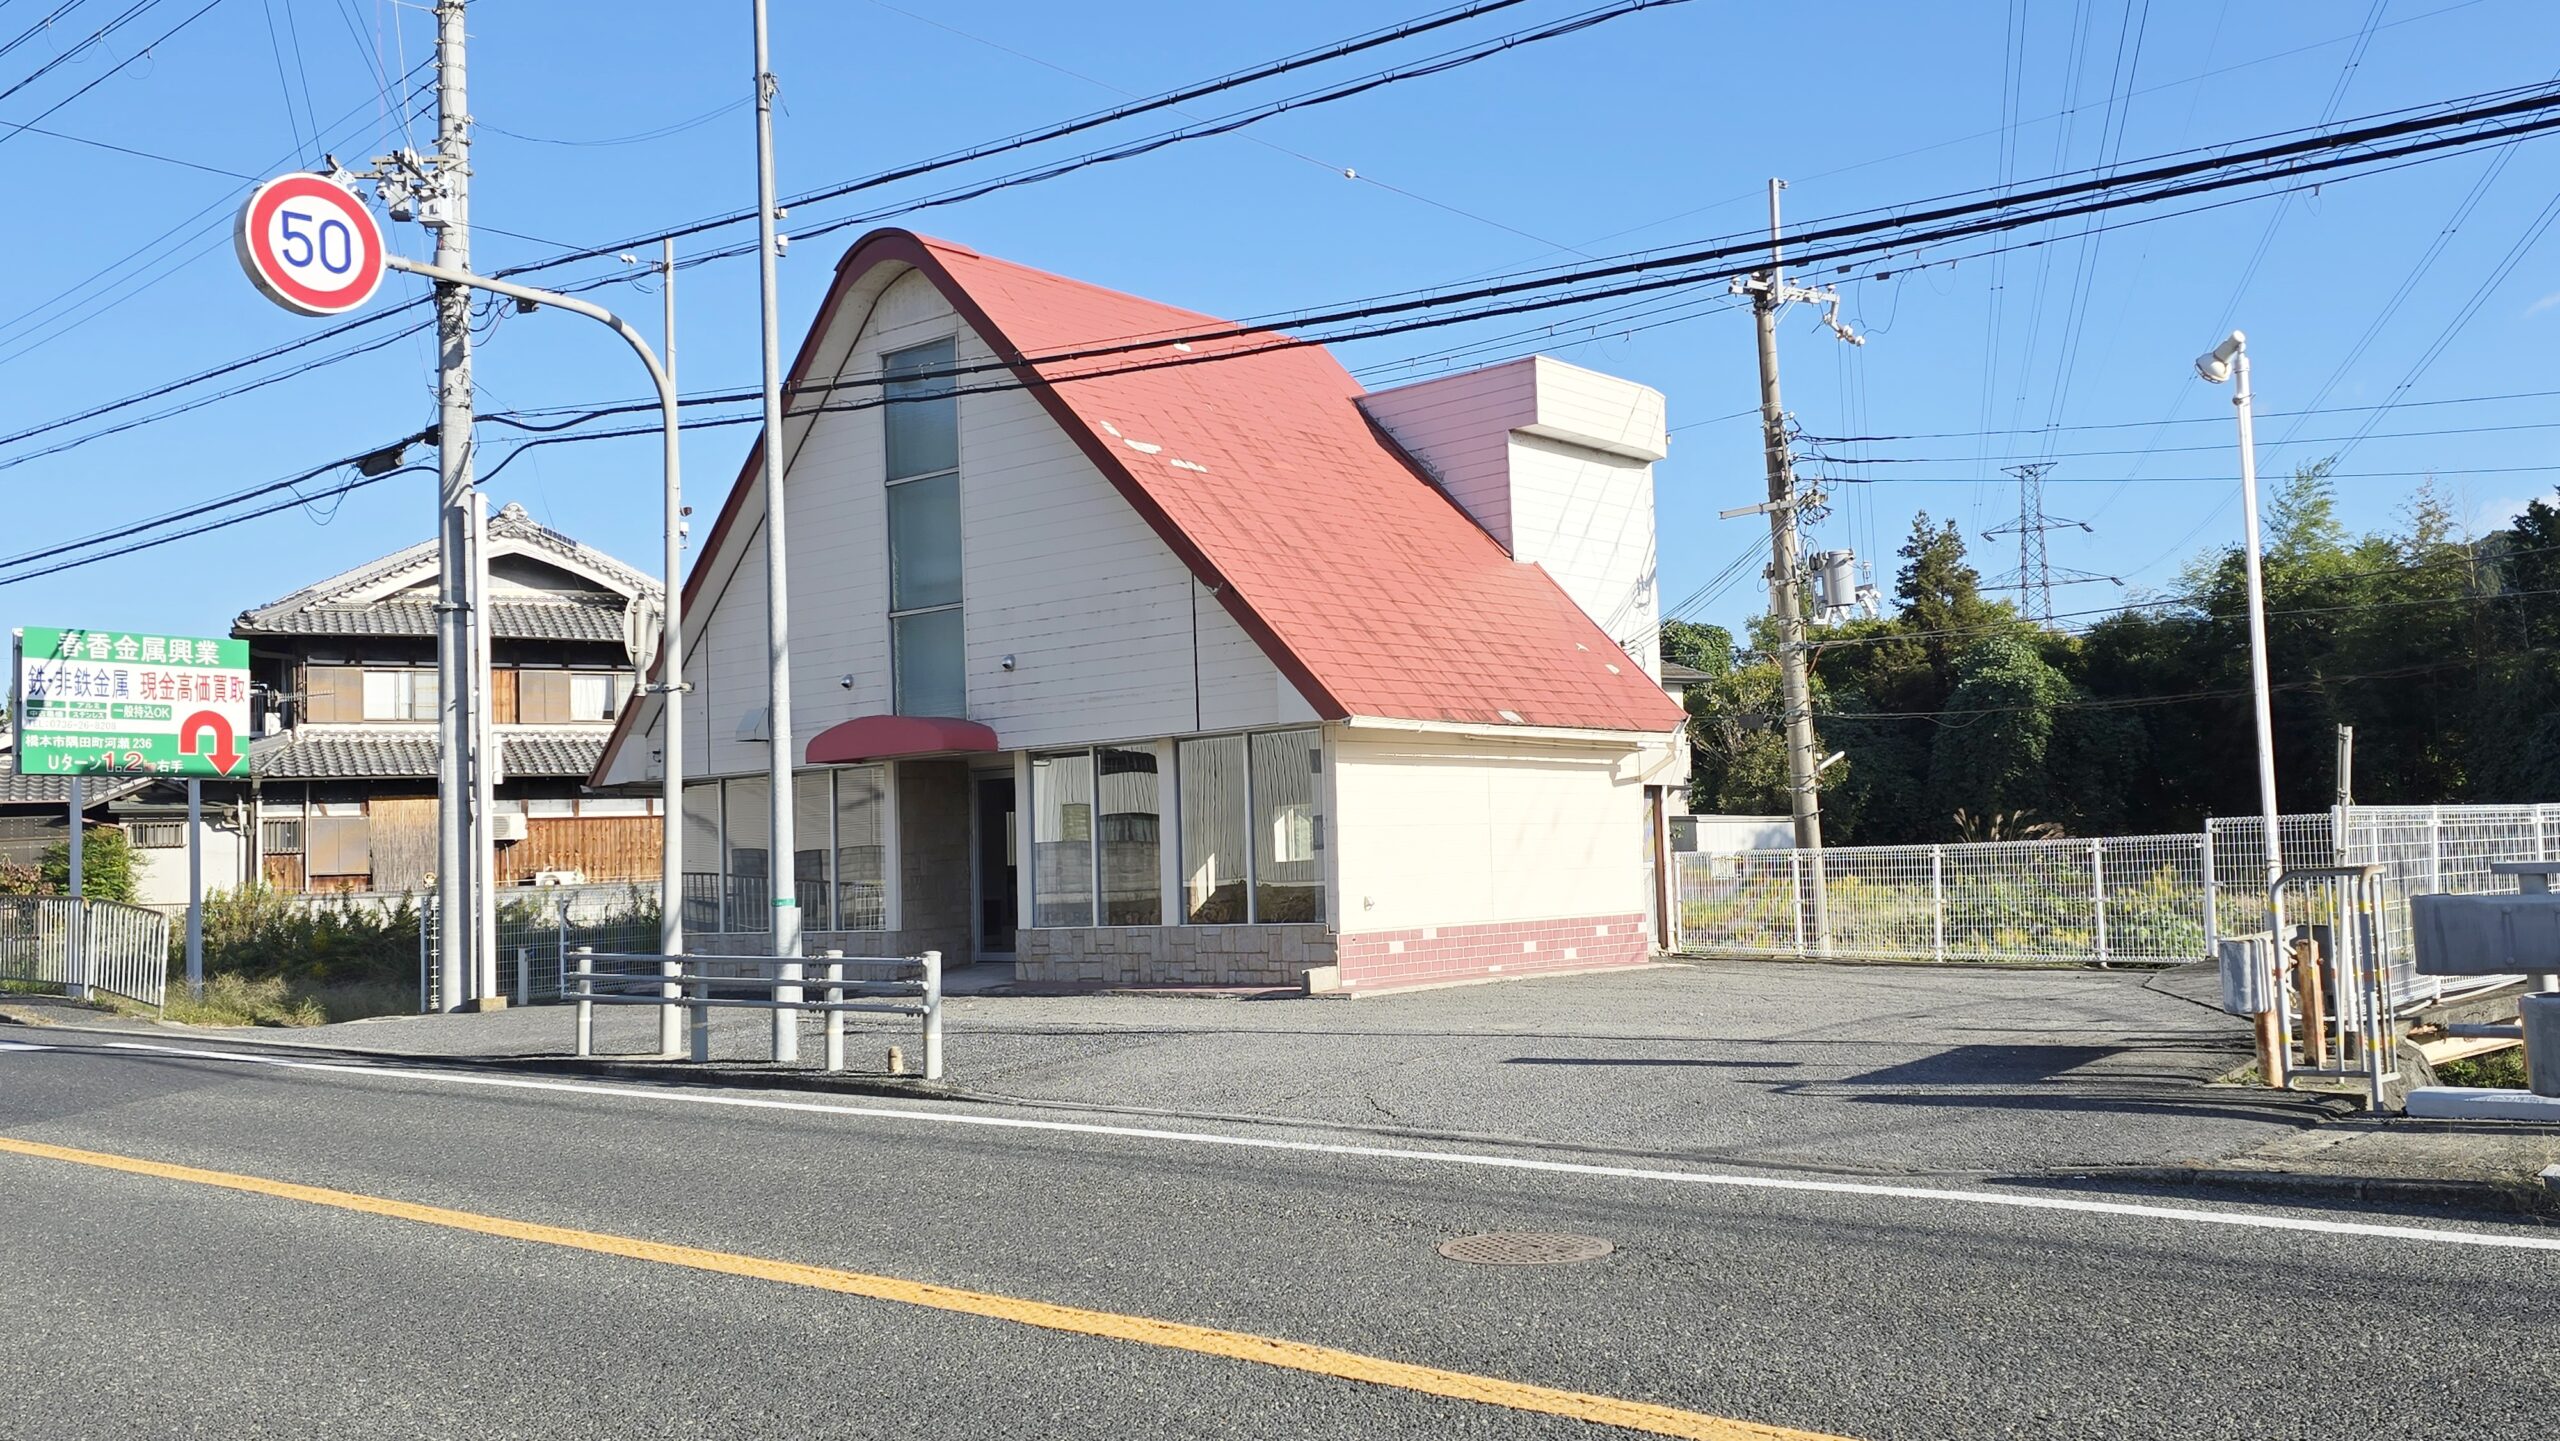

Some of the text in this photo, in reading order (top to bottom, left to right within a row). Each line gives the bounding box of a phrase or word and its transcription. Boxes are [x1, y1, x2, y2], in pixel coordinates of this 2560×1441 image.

[281, 210, 352, 274] 50
[58, 631, 220, 665] 春香金属興業
[28, 664, 245, 703] 鉄・非鉄金属 現金高価買取
[132, 738, 153, 749] 236
